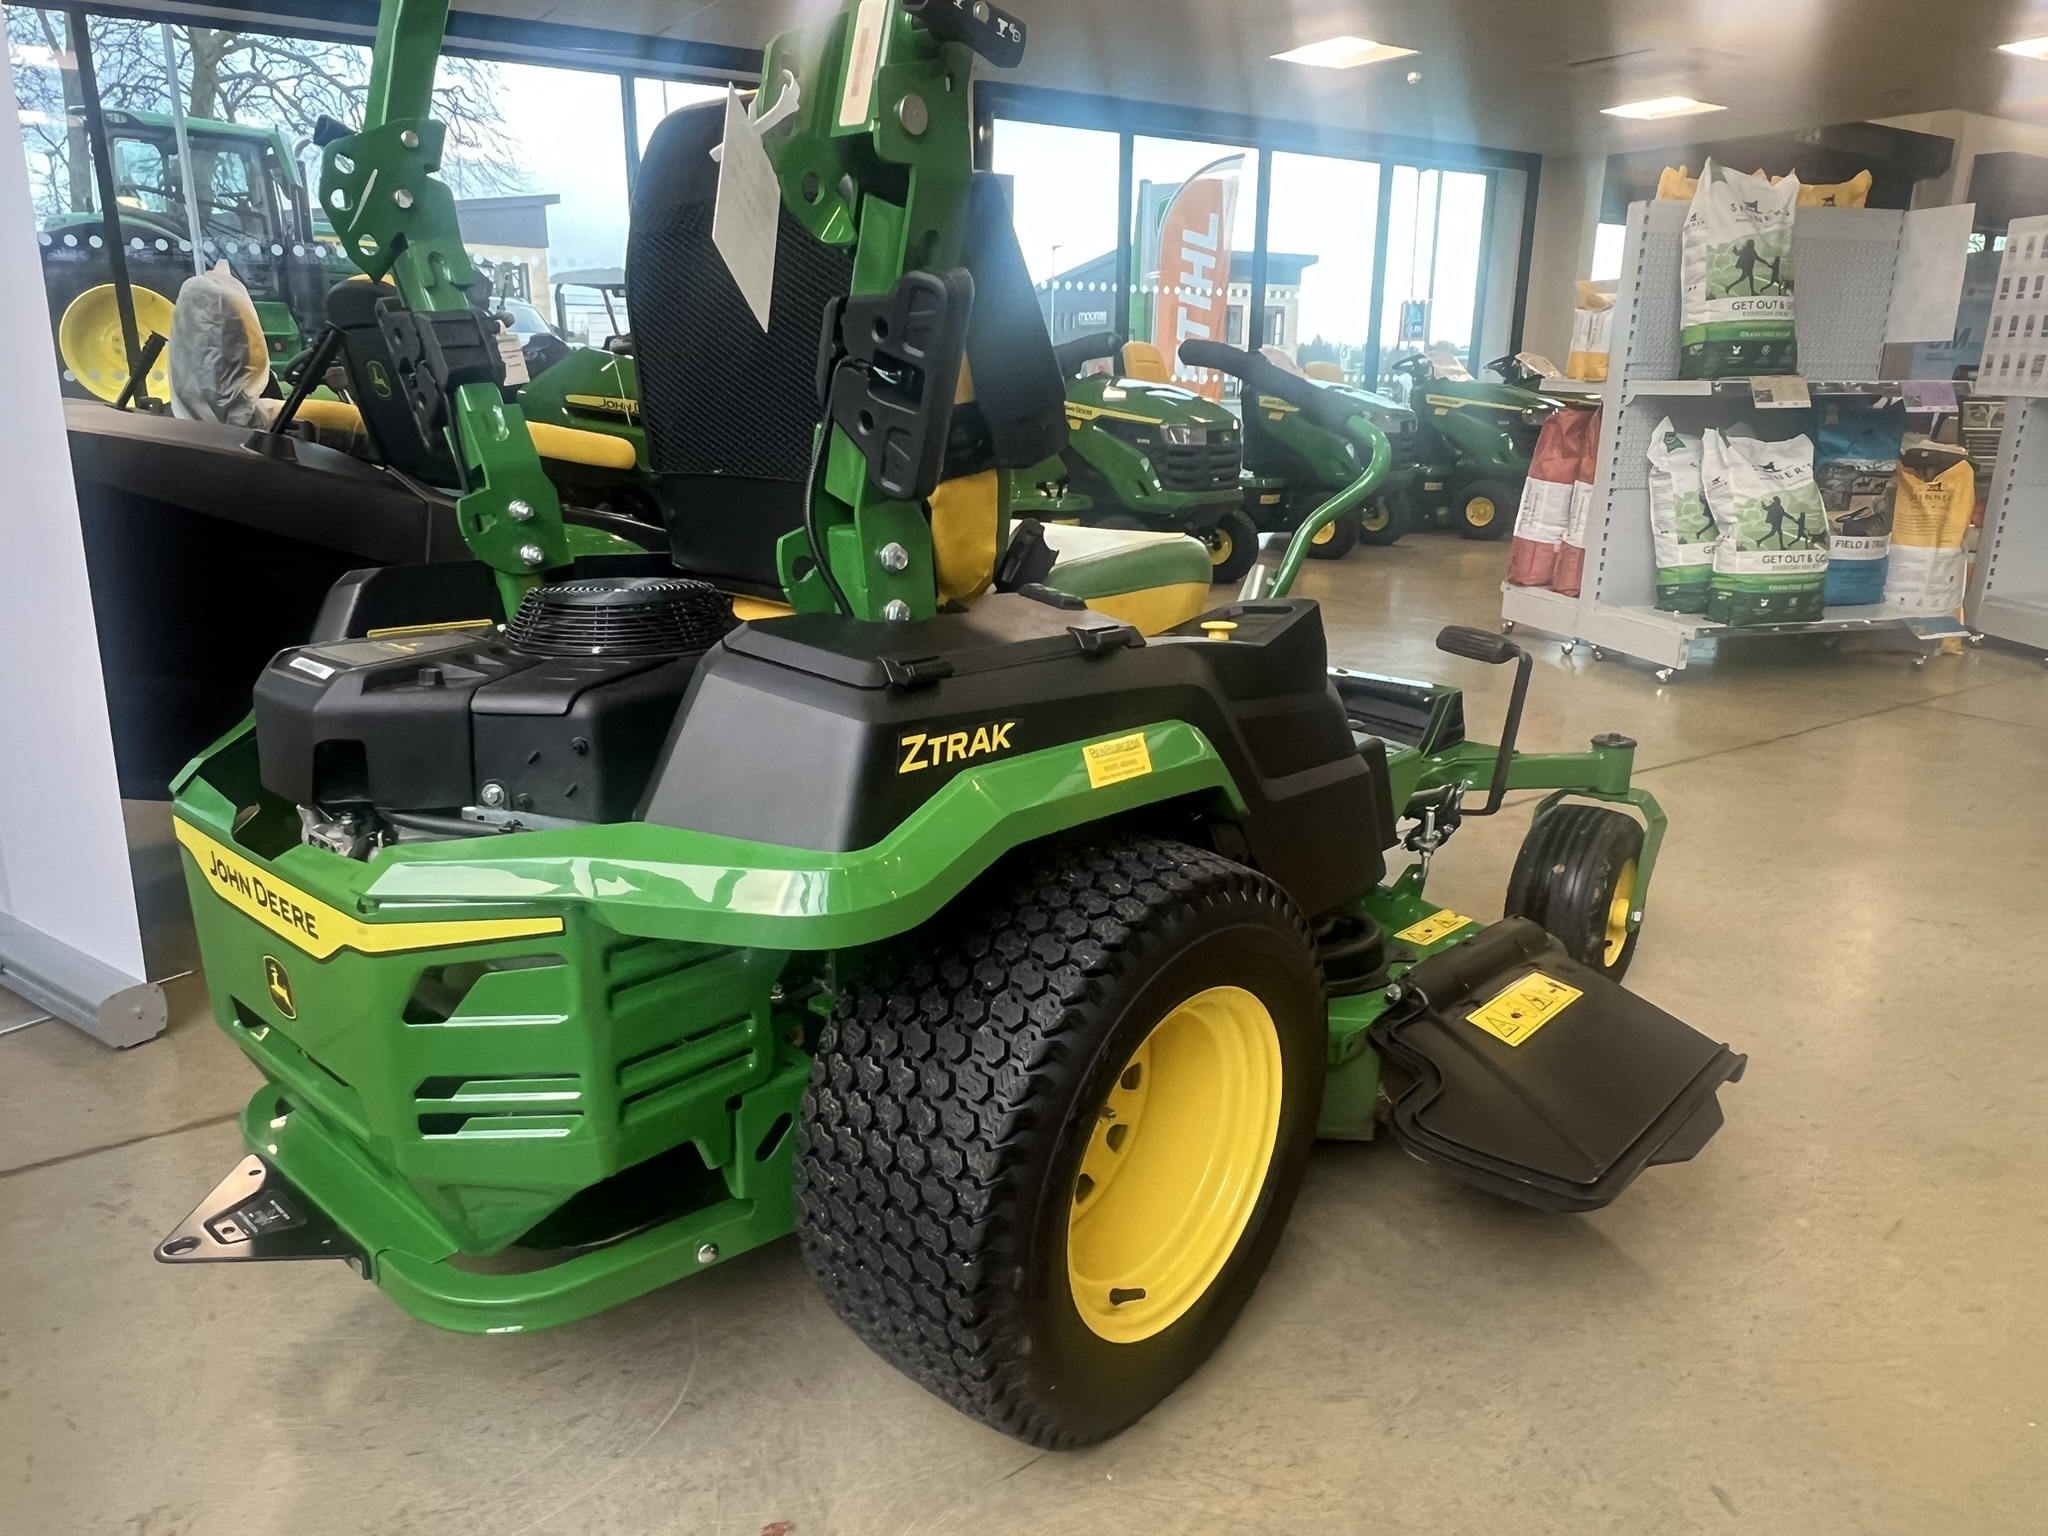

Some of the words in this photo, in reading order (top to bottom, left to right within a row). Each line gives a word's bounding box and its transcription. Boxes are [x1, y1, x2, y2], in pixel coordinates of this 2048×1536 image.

[1732, 301, 1755, 310] GET
[1756, 300, 1778, 310] OUT
[1779, 301, 1785, 309] &
[600, 398, 631, 411] JOHN
[1835, 540, 1863, 549] FIELD
[1864, 540, 1870, 549] &
[1762, 555, 1783, 564] GET
[1785, 554, 1807, 563] OUT
[1807, 554, 1813, 563] &
[899, 722, 1015, 774] ZTRAK
[210, 850, 252, 899] JOHN
[252, 876, 319, 940] DEERE
